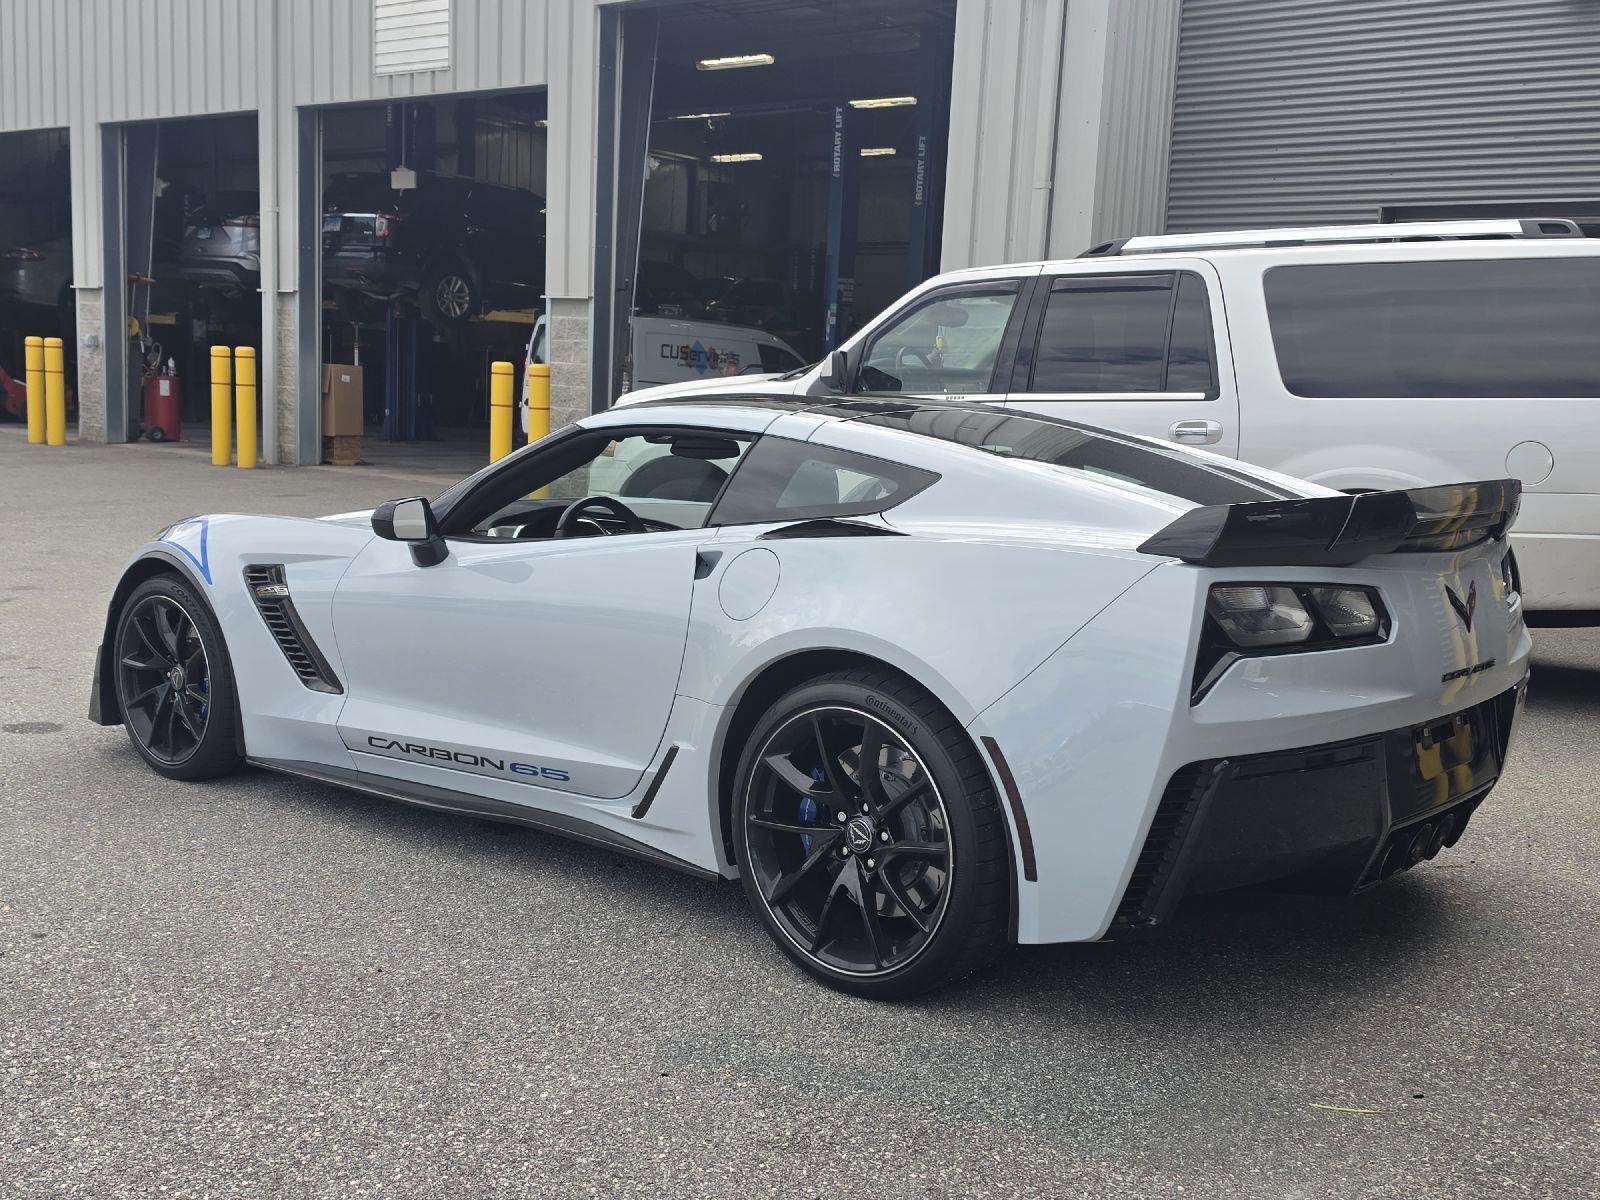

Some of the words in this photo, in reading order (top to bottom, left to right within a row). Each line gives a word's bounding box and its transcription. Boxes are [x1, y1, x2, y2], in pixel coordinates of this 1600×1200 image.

[835, 107, 843, 128] LIFT
[833, 131, 842, 172] ROTARY
[918, 136, 926, 157] LIFT
[915, 159, 925, 200] ROTARY
[865, 694, 914, 730] Continental
[367, 735, 504, 771] CARBON
[509, 762, 570, 782] 65
